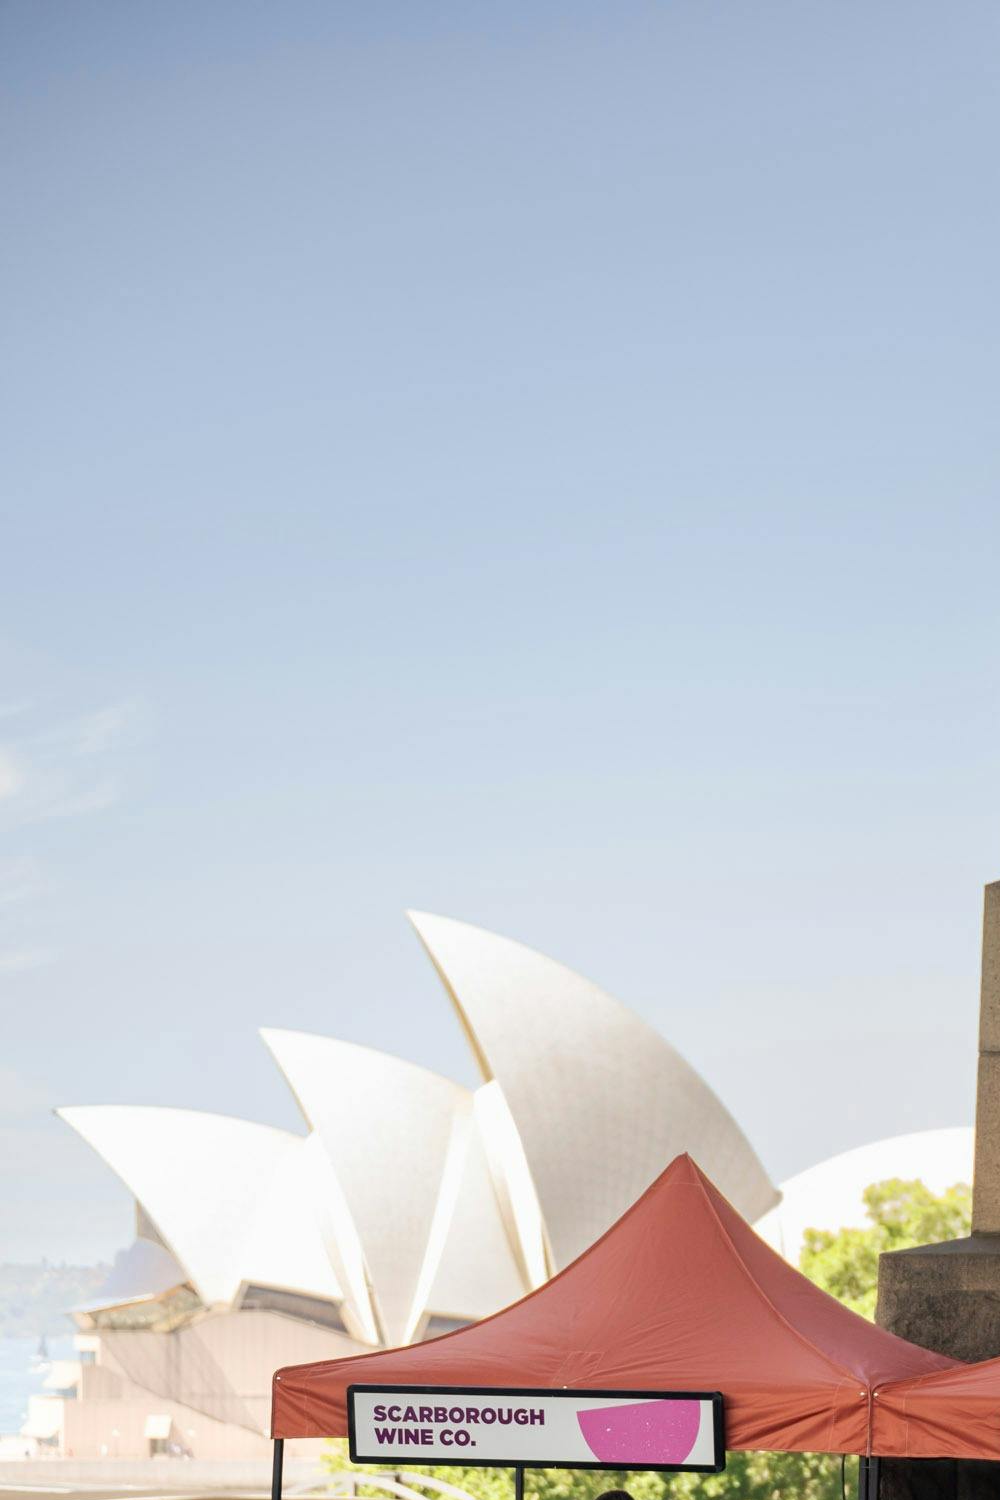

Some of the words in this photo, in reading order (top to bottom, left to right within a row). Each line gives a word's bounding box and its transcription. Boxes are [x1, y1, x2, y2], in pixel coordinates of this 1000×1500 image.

[373, 1405, 545, 1426] SCARBOROUGH
[374, 1427, 434, 1445] WINE
[439, 1429, 477, 1447] CO.
